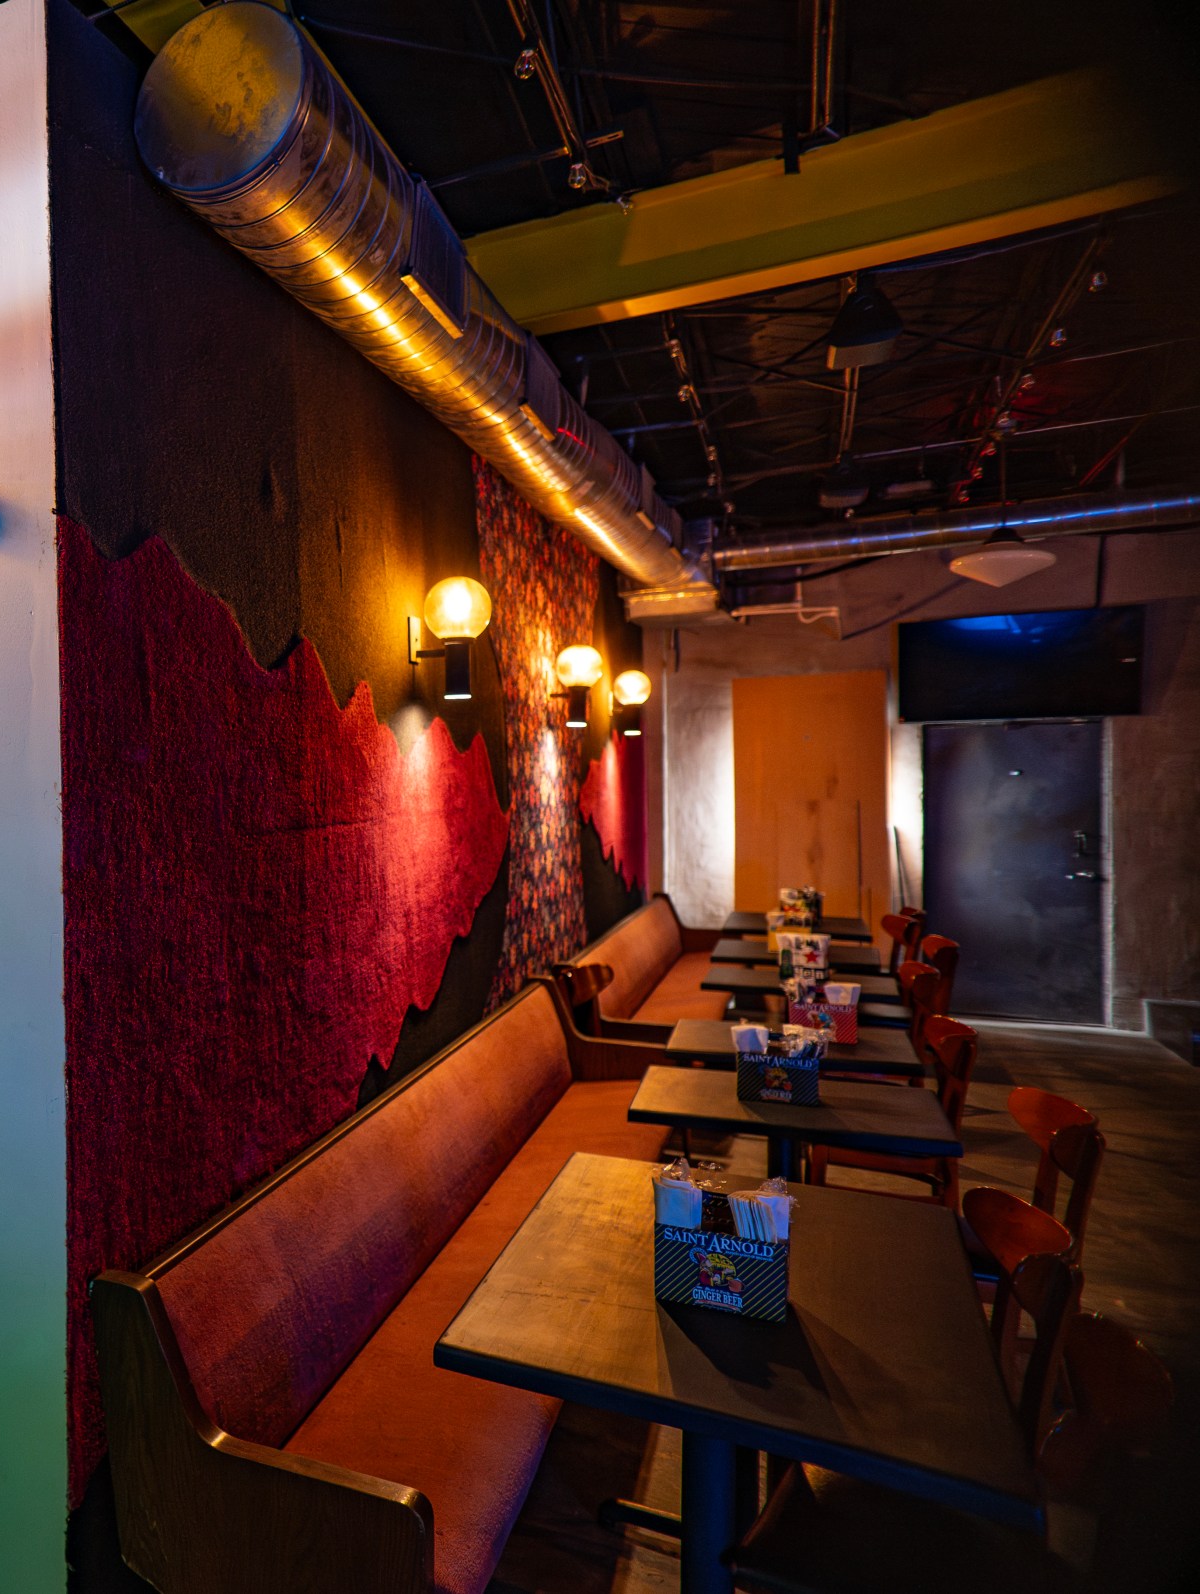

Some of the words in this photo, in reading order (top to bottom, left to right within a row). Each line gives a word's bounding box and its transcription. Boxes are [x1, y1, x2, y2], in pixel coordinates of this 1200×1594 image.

[818, 1004, 852, 1013] ARNOLD
[743, 1054, 772, 1064] SAINT
[771, 1056, 813, 1068] ARNOLD
[664, 1227, 708, 1247] SAINT
[707, 1235, 774, 1258] ARNOLD
[692, 1288, 722, 1303] GINGER
[723, 1294, 743, 1309] BEER
